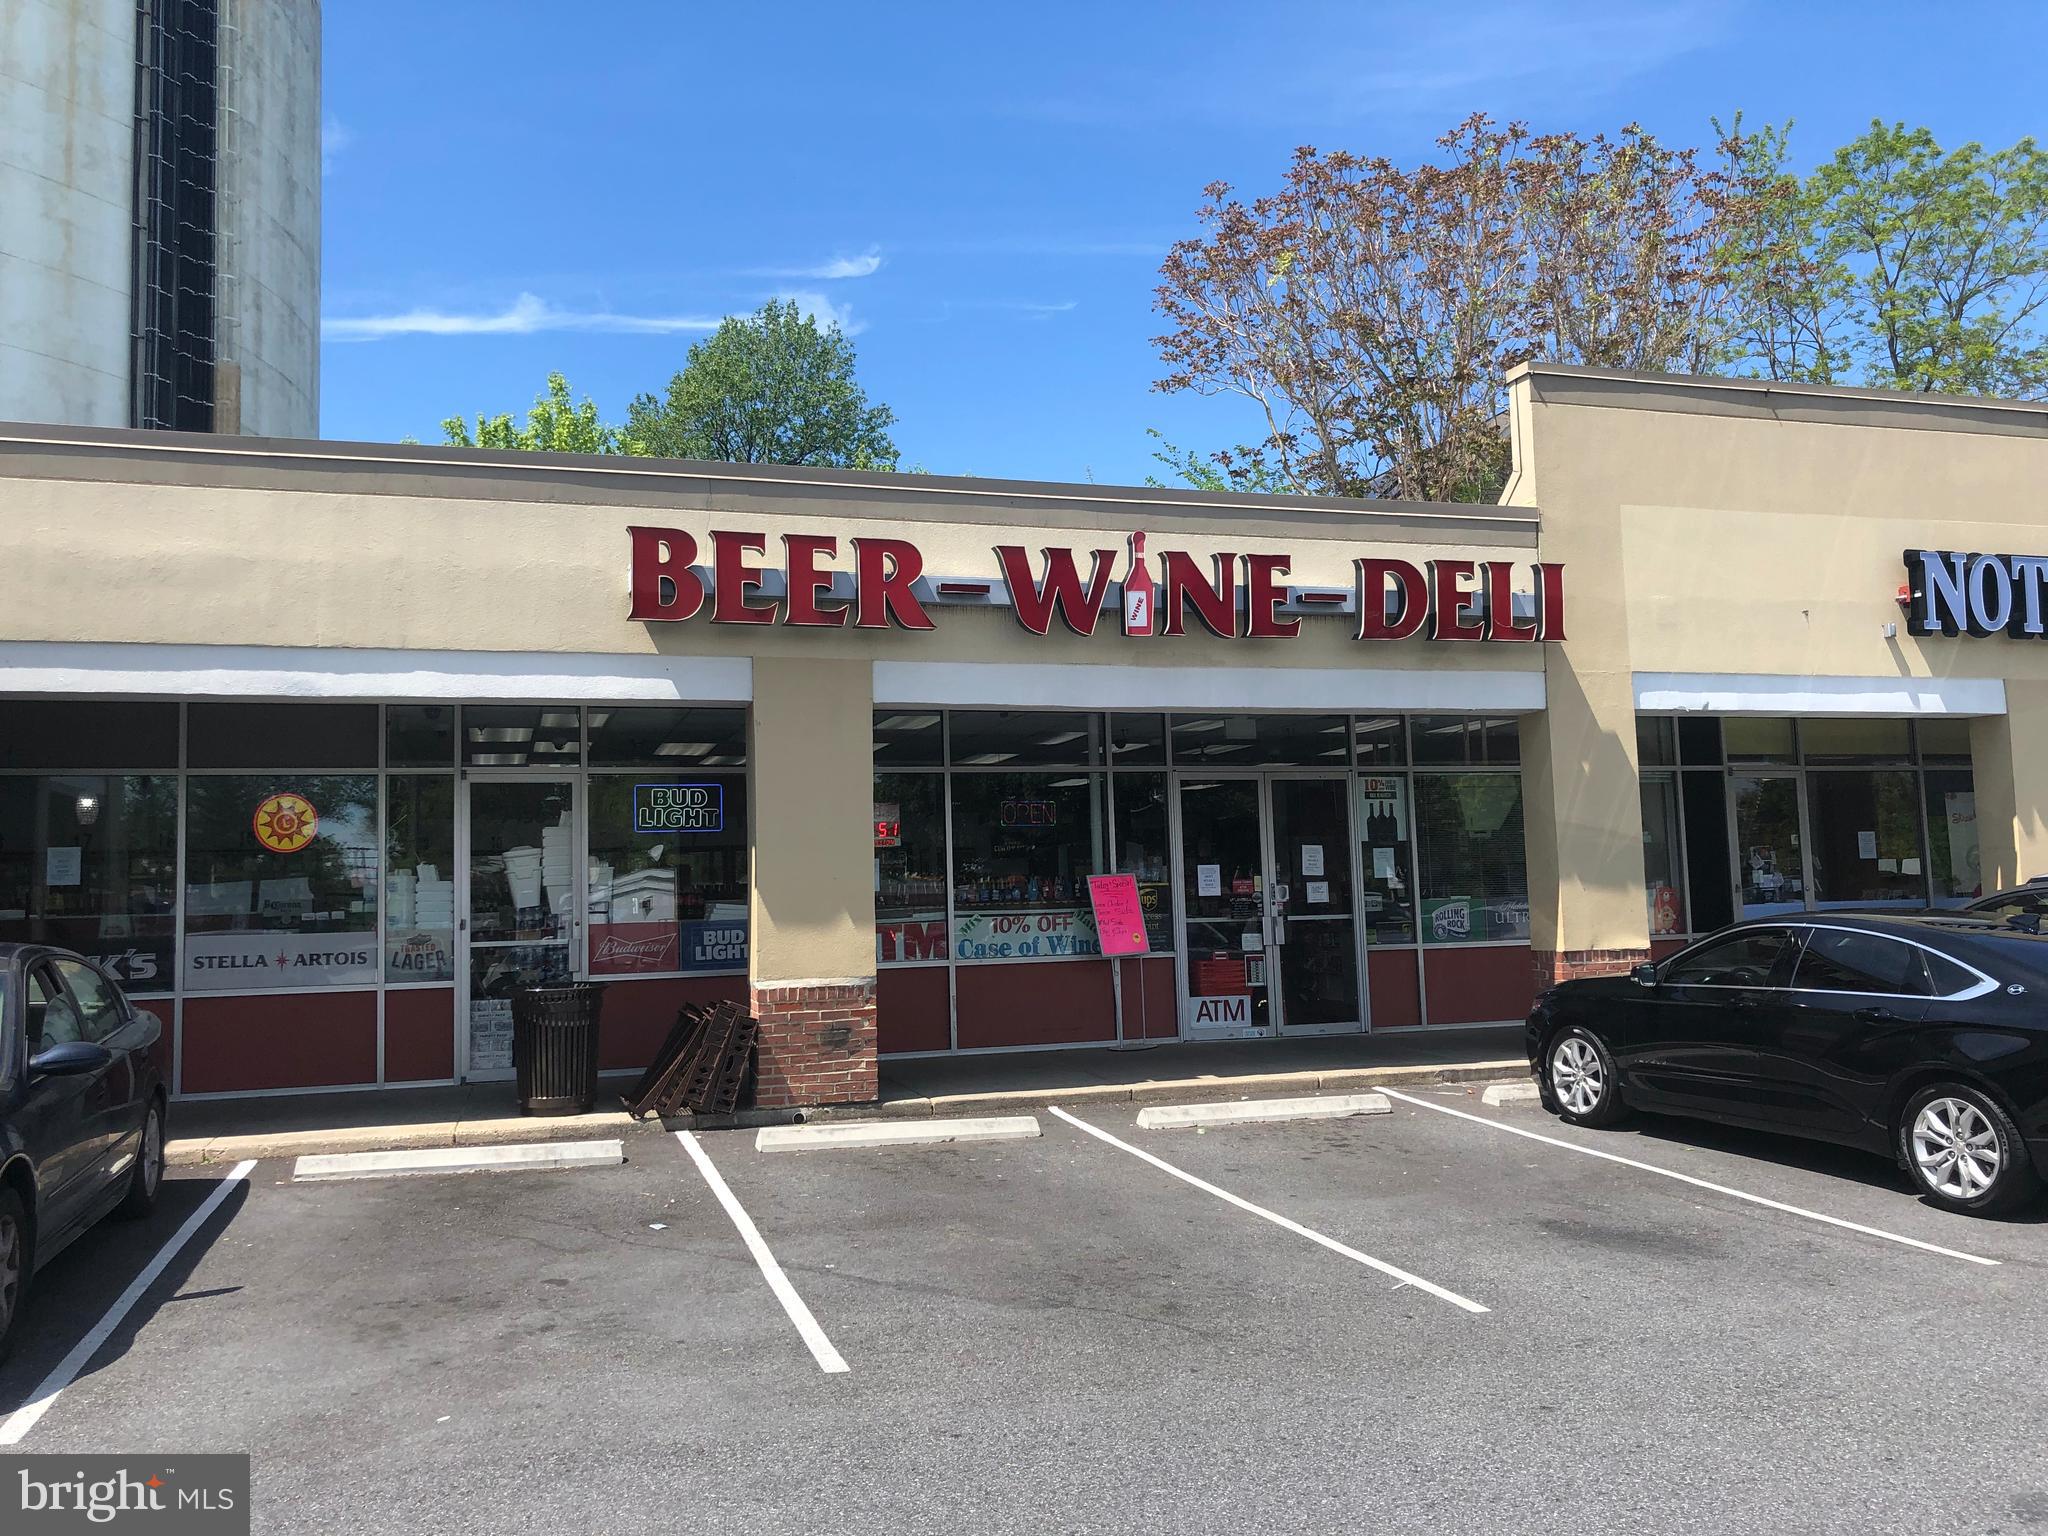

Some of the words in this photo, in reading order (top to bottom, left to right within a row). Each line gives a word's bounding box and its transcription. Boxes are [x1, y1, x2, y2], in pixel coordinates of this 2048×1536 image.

[1919, 551, 2048, 633] NOT
[1130, 597, 1144, 621] WINE
[651, 788, 708, 808] BUD
[639, 808, 719, 828] LIGHT
[1003, 803, 1054, 825] OPEN
[1141, 895, 1157, 908] ups
[959, 912, 984, 937] Mix
[991, 915, 1031, 934] 10%
[1037, 914, 1075, 931] OFF
[1434, 908, 1465, 923] ROLLING
[1446, 920, 1466, 931] ROCK
[1145, 922, 1159, 930] oint
[602, 940, 666, 955] Budweiser
[703, 930, 745, 945] BUD
[958, 938, 1000, 959] Case
[1019, 936, 1040, 957] of
[193, 954, 269, 970] STELLA
[294, 951, 368, 967] ARTOIS
[392, 950, 448, 970] LAGER
[1196, 999, 1245, 1023] ATM
